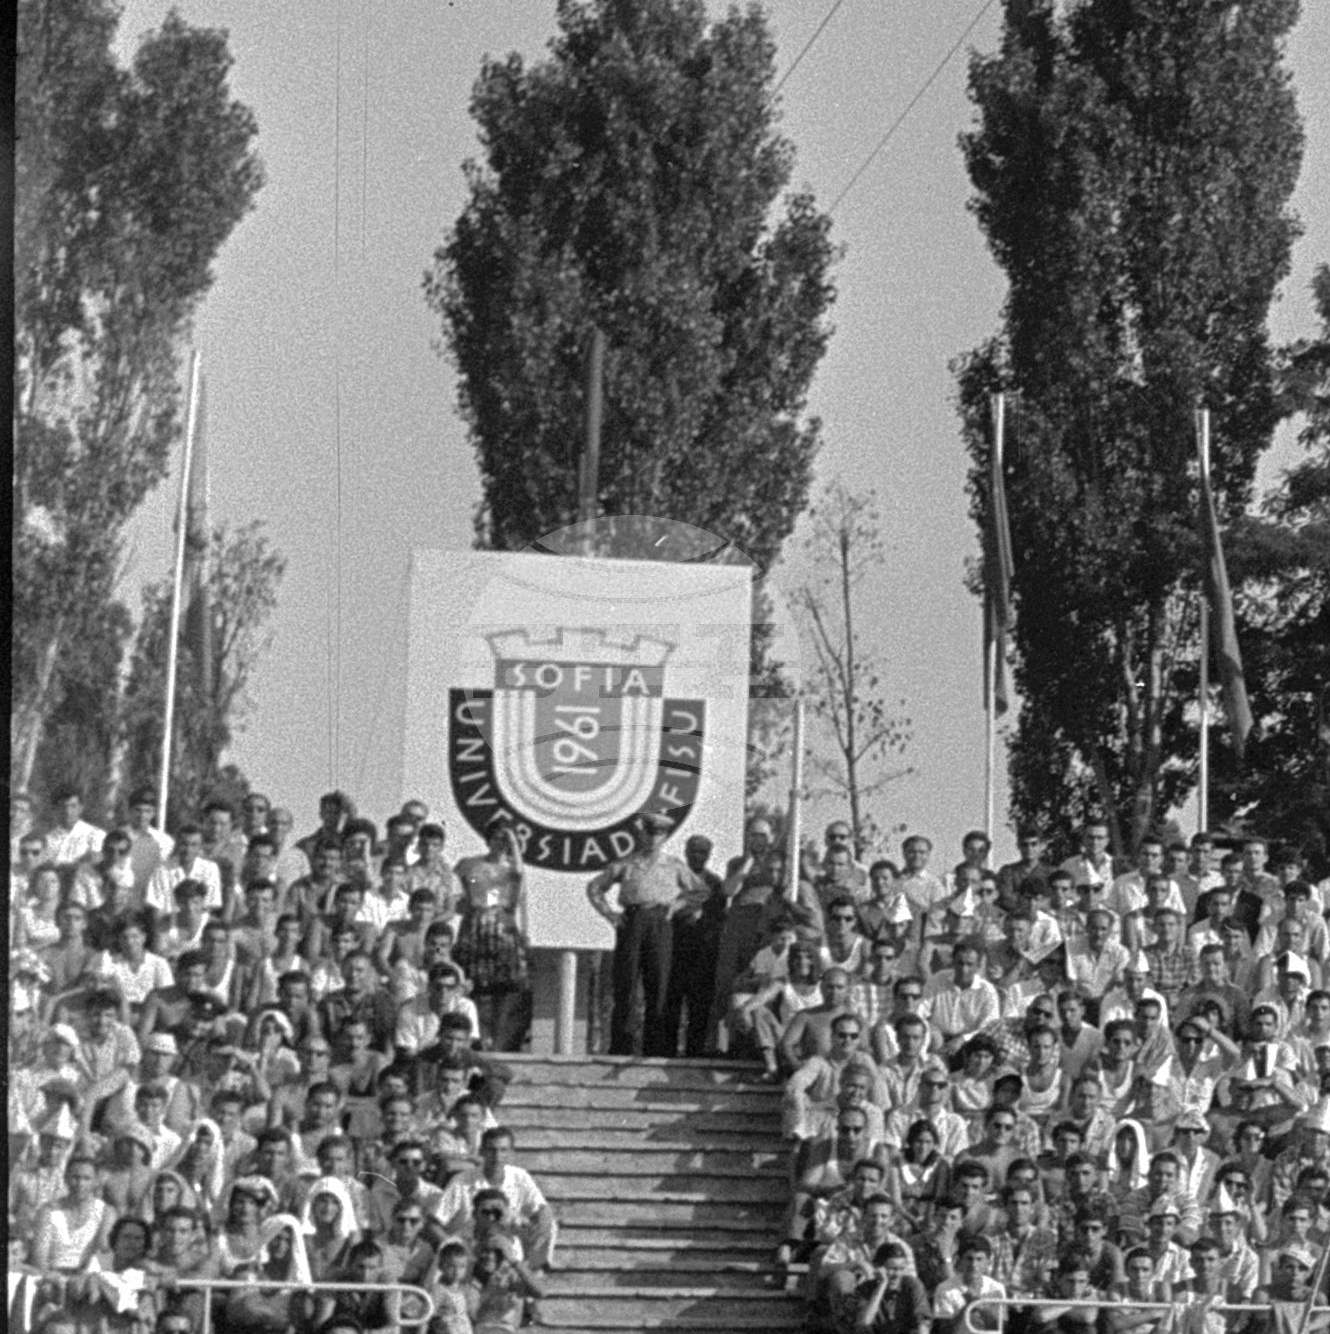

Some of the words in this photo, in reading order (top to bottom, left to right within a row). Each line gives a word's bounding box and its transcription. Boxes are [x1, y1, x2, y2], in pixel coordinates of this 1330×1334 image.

[512, 663, 651, 696] SOFIA
[552, 704, 601, 776] 1961
[455, 700, 645, 866] UNIVRSIAD
[658, 709, 698, 807] FISU
